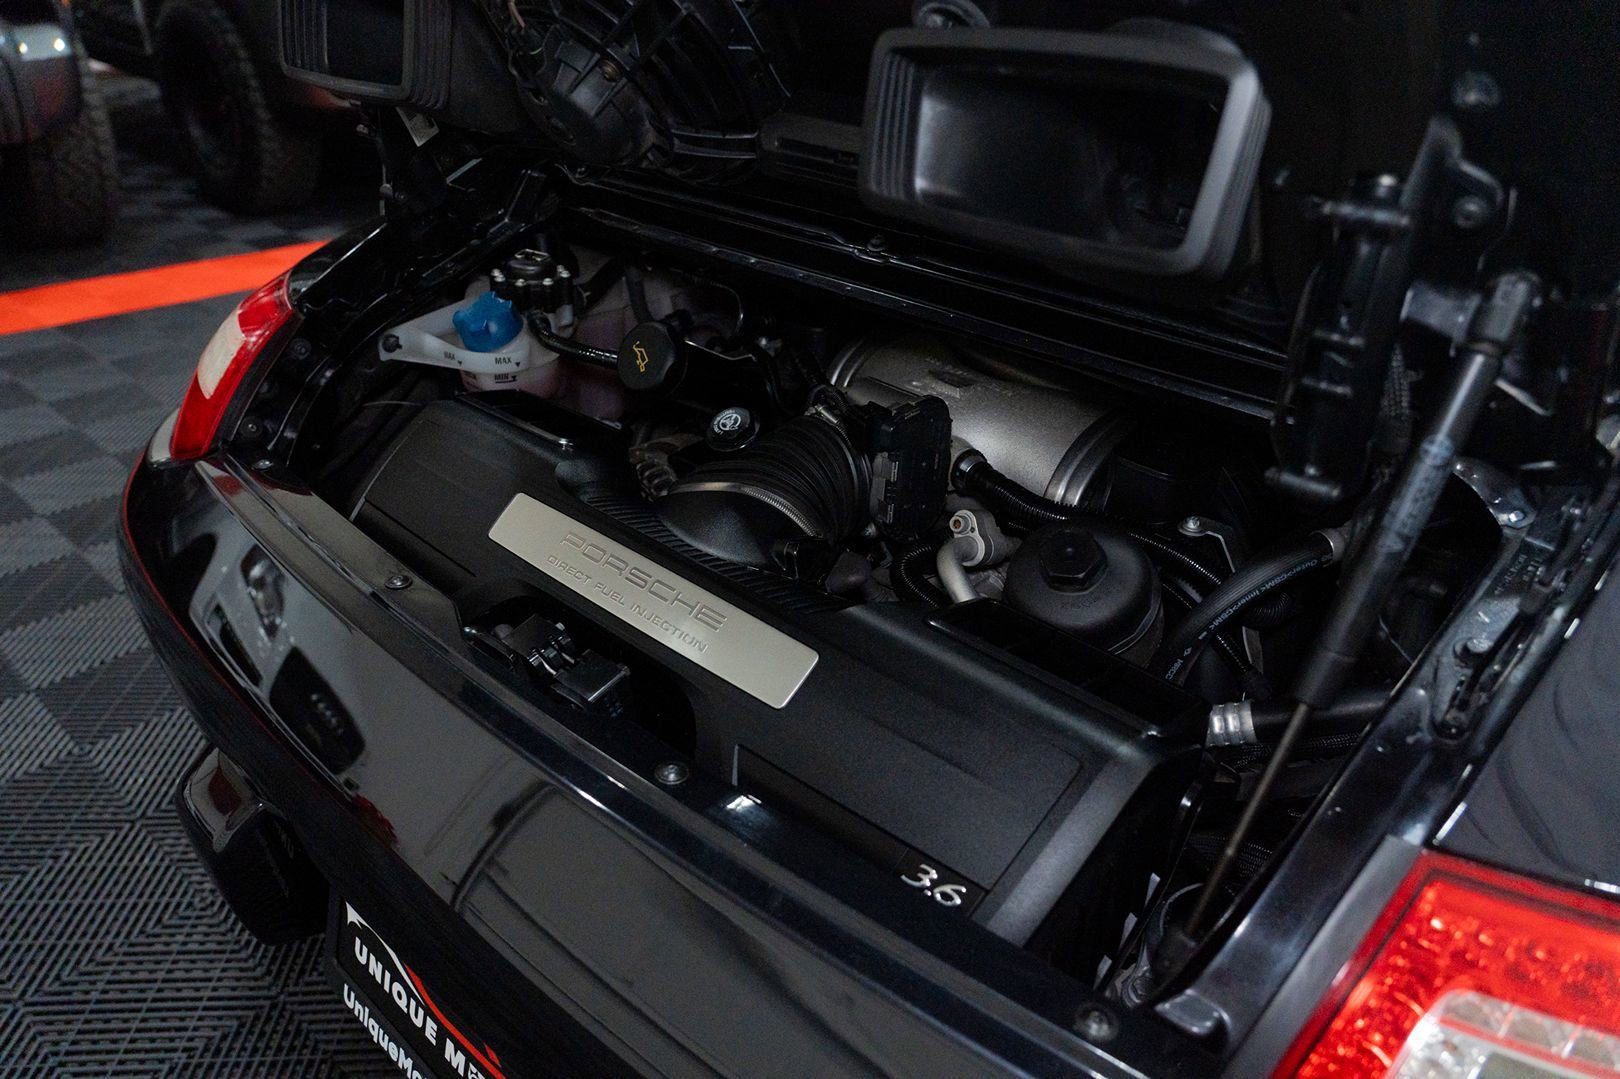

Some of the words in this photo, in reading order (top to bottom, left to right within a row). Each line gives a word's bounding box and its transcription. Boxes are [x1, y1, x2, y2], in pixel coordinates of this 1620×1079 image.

[547, 555, 592, 584] DIRECT
[593, 582, 625, 606] FUEL
[629, 602, 710, 653] INJECTION
[560, 531, 728, 633] PORSCHE
[900, 864, 967, 906] 3.6
[343, 983, 431, 1079] UniqueMo
[354, 935, 438, 1047] UNIQUE
